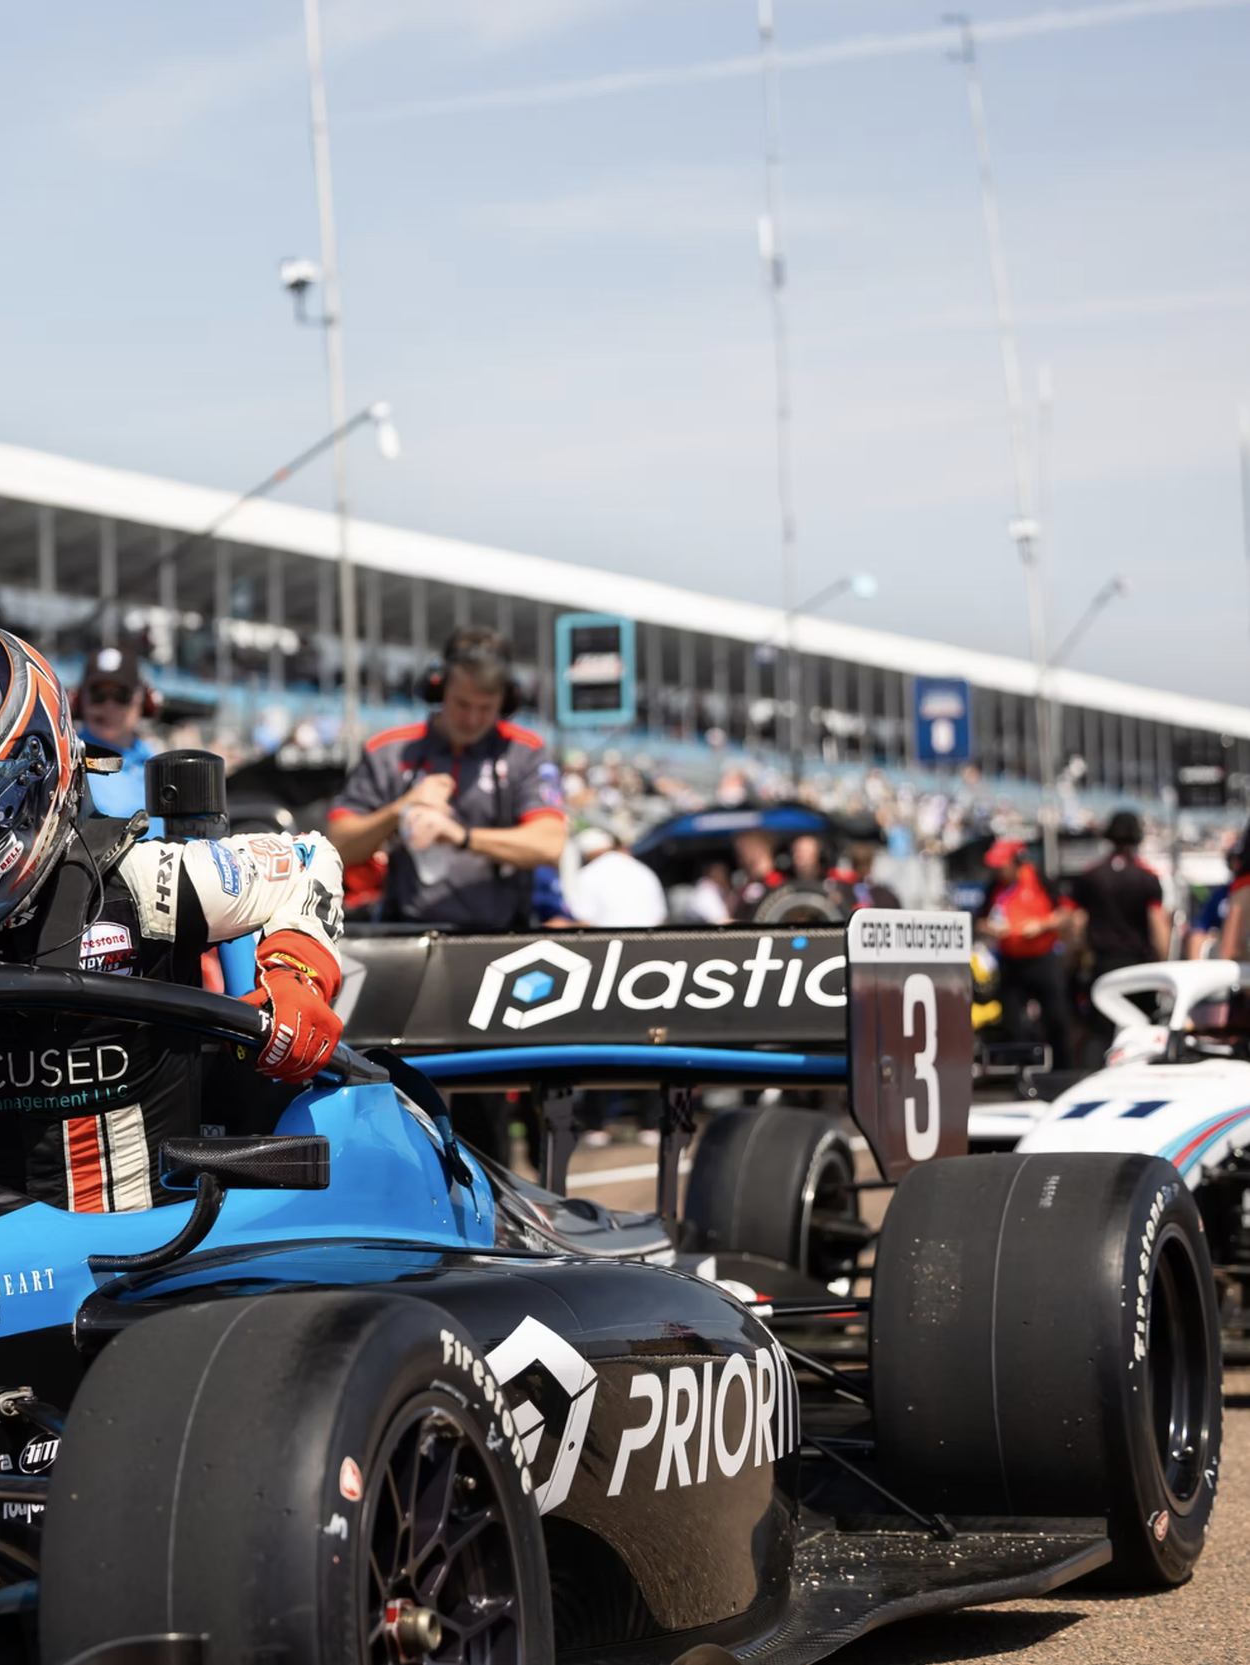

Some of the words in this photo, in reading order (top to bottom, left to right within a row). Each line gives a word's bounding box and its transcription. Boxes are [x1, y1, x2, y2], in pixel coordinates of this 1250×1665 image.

[0, 846, 22, 871] BELL
[155, 848, 174, 915] HRX
[81, 934, 125, 950] restone
[861, 922, 891, 956] cape
[896, 917, 963, 957] motorsports
[903, 973, 941, 1161] 3
[94, 1084, 128, 1101] LLC
[440, 1328, 532, 1496] Firestone
